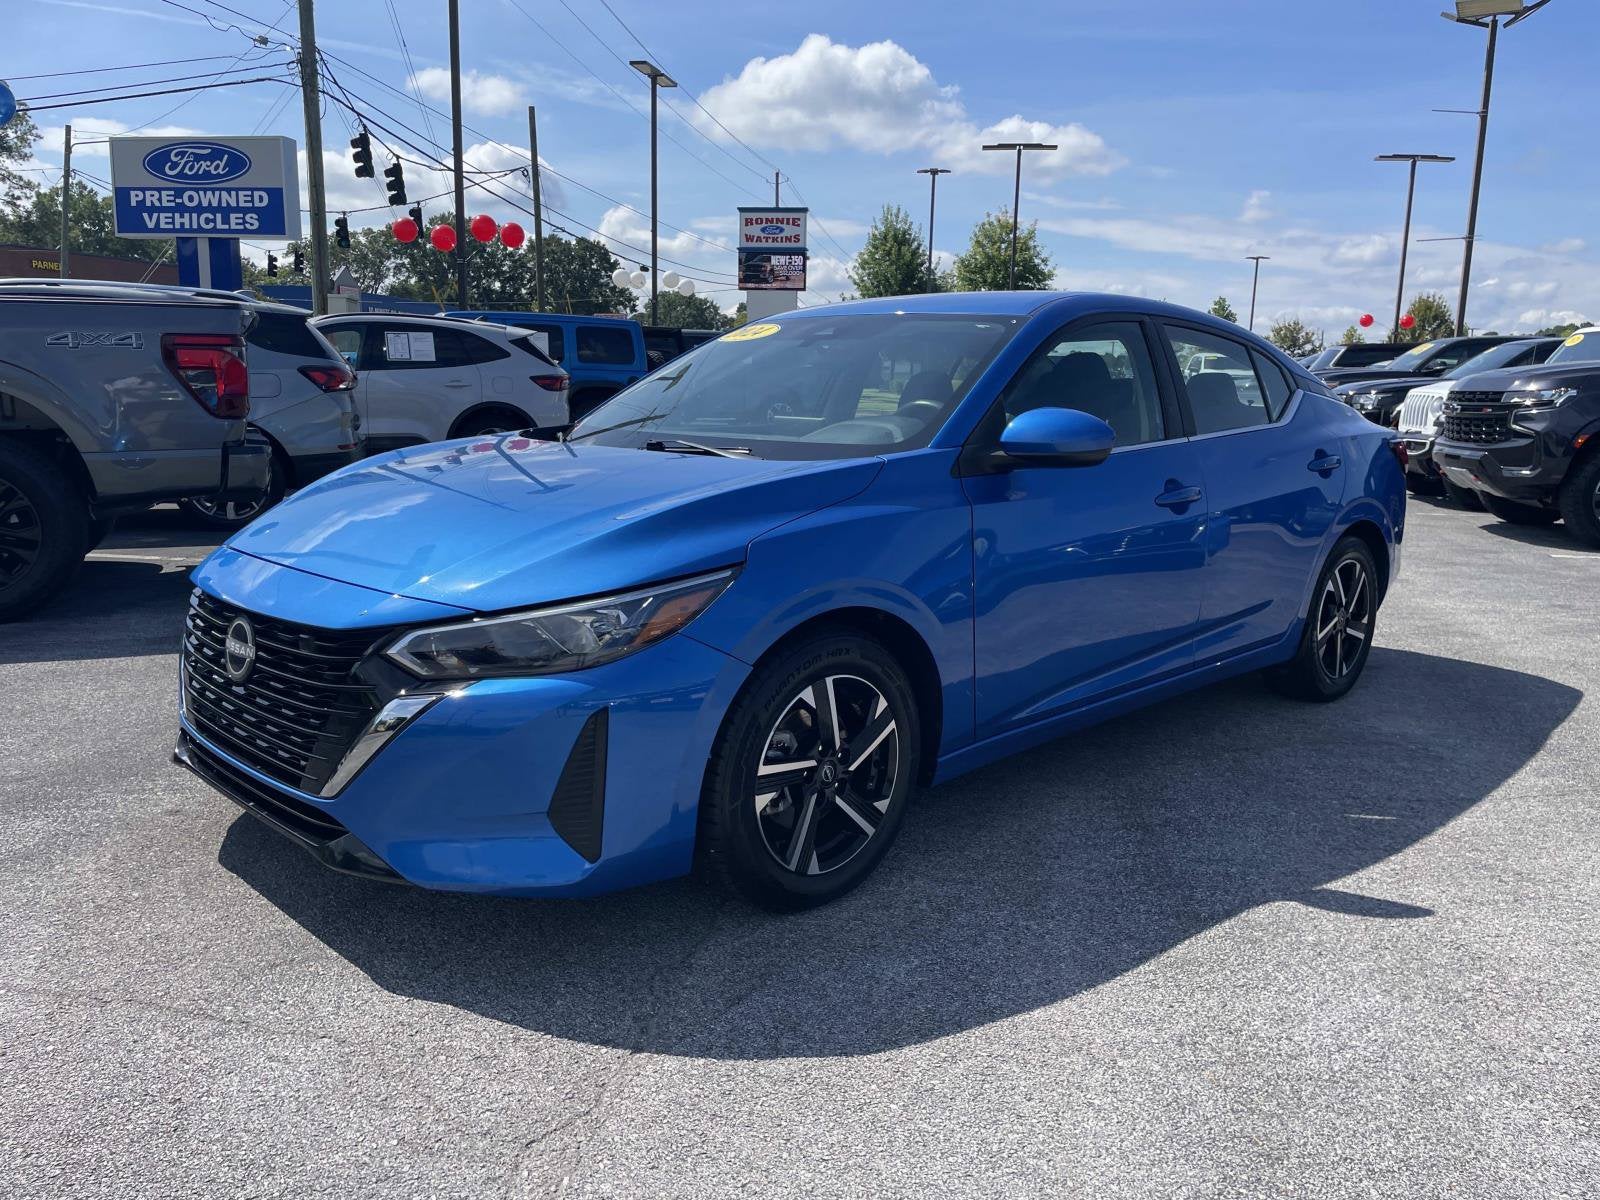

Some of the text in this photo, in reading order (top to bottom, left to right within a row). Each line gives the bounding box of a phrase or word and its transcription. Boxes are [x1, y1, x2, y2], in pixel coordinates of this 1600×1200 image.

[164, 148, 229, 176] Ford
[129, 190, 269, 207] PRE-OWNED
[142, 212, 260, 230] VEHICLES
[744, 217, 801, 228] RONNIE
[764, 226, 780, 234] Ford
[744, 233, 801, 244] WATKINS
[771, 255, 804, 266] NEW F-150
